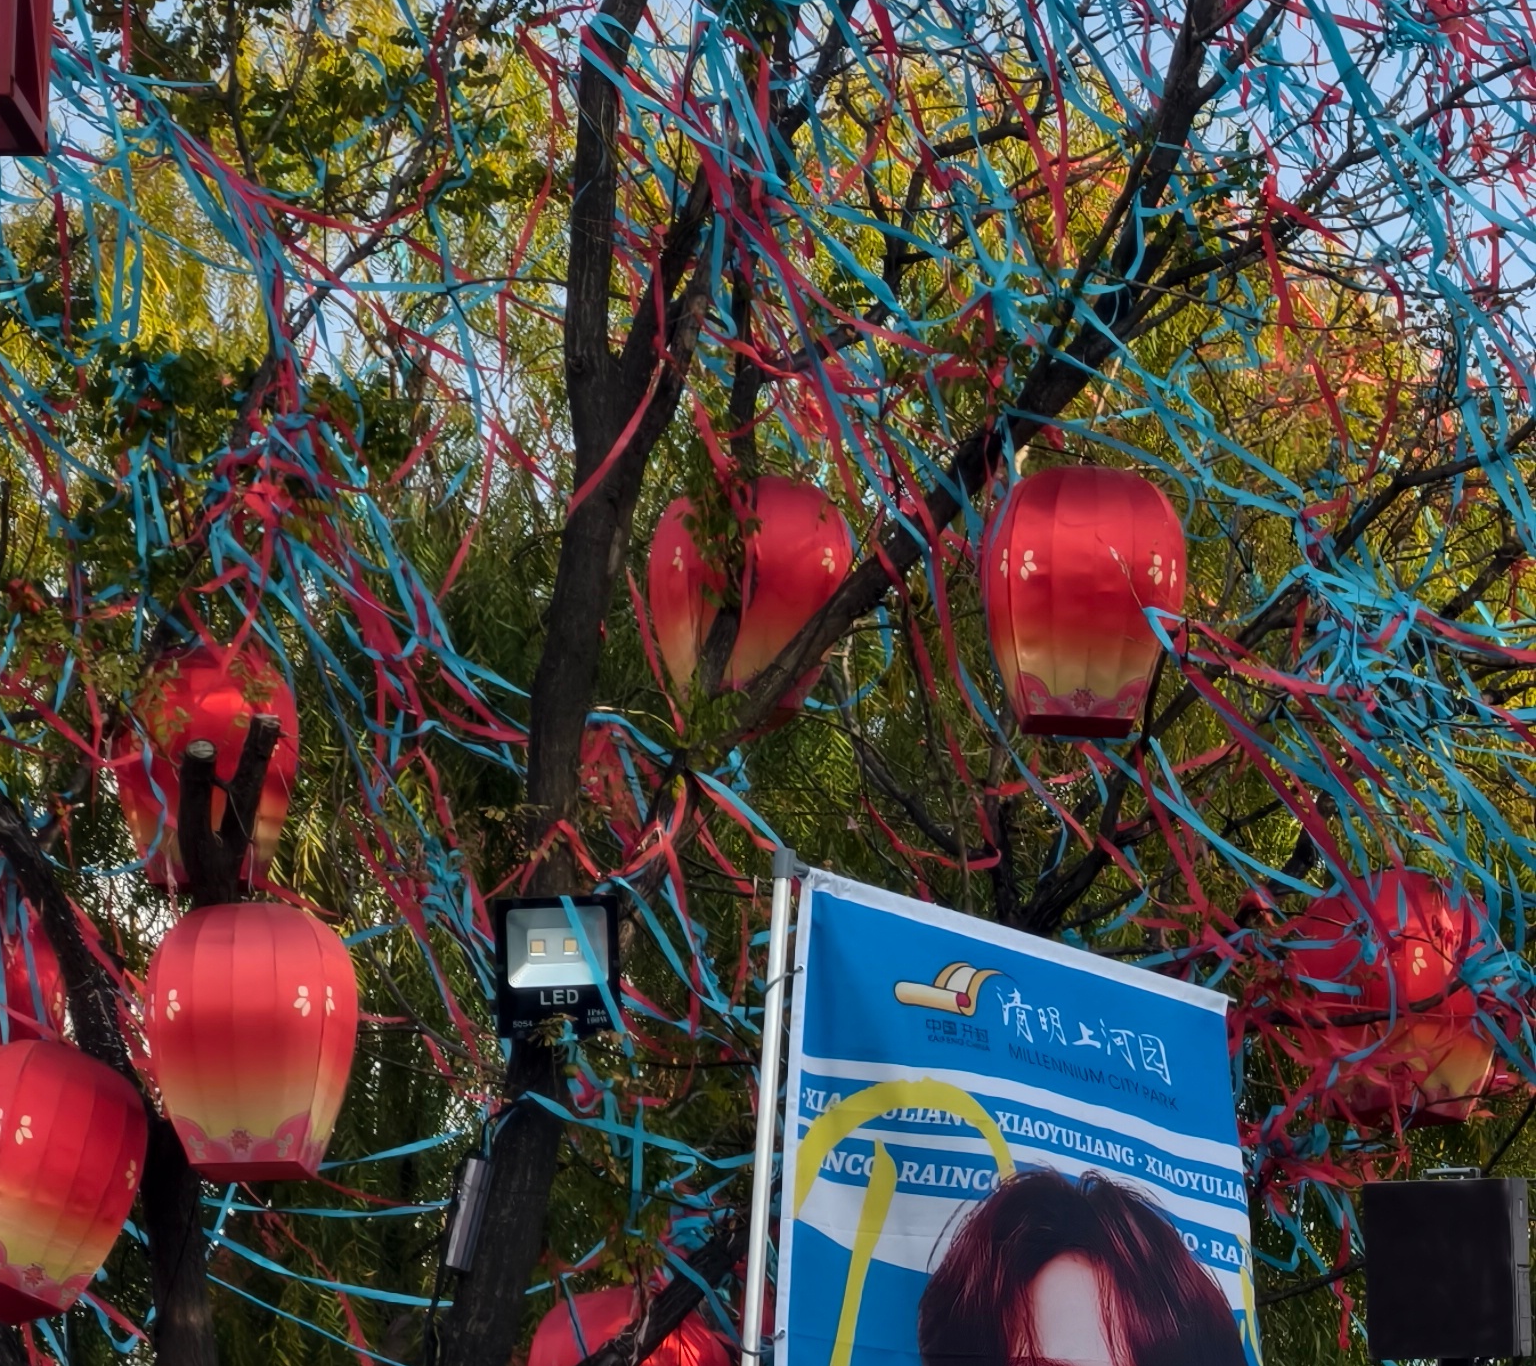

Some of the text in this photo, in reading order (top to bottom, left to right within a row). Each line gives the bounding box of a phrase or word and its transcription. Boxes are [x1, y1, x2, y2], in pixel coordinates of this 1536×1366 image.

[540, 989, 579, 1006] LED
[996, 986, 1172, 1086] 清明上河园
[1007, 1042, 1180, 1112] MILLENNIUM CITY PARK
[995, 1110, 1135, 1168] XIAOYULIANG
[1145, 1153, 1248, 1207] XIAOYULIA
